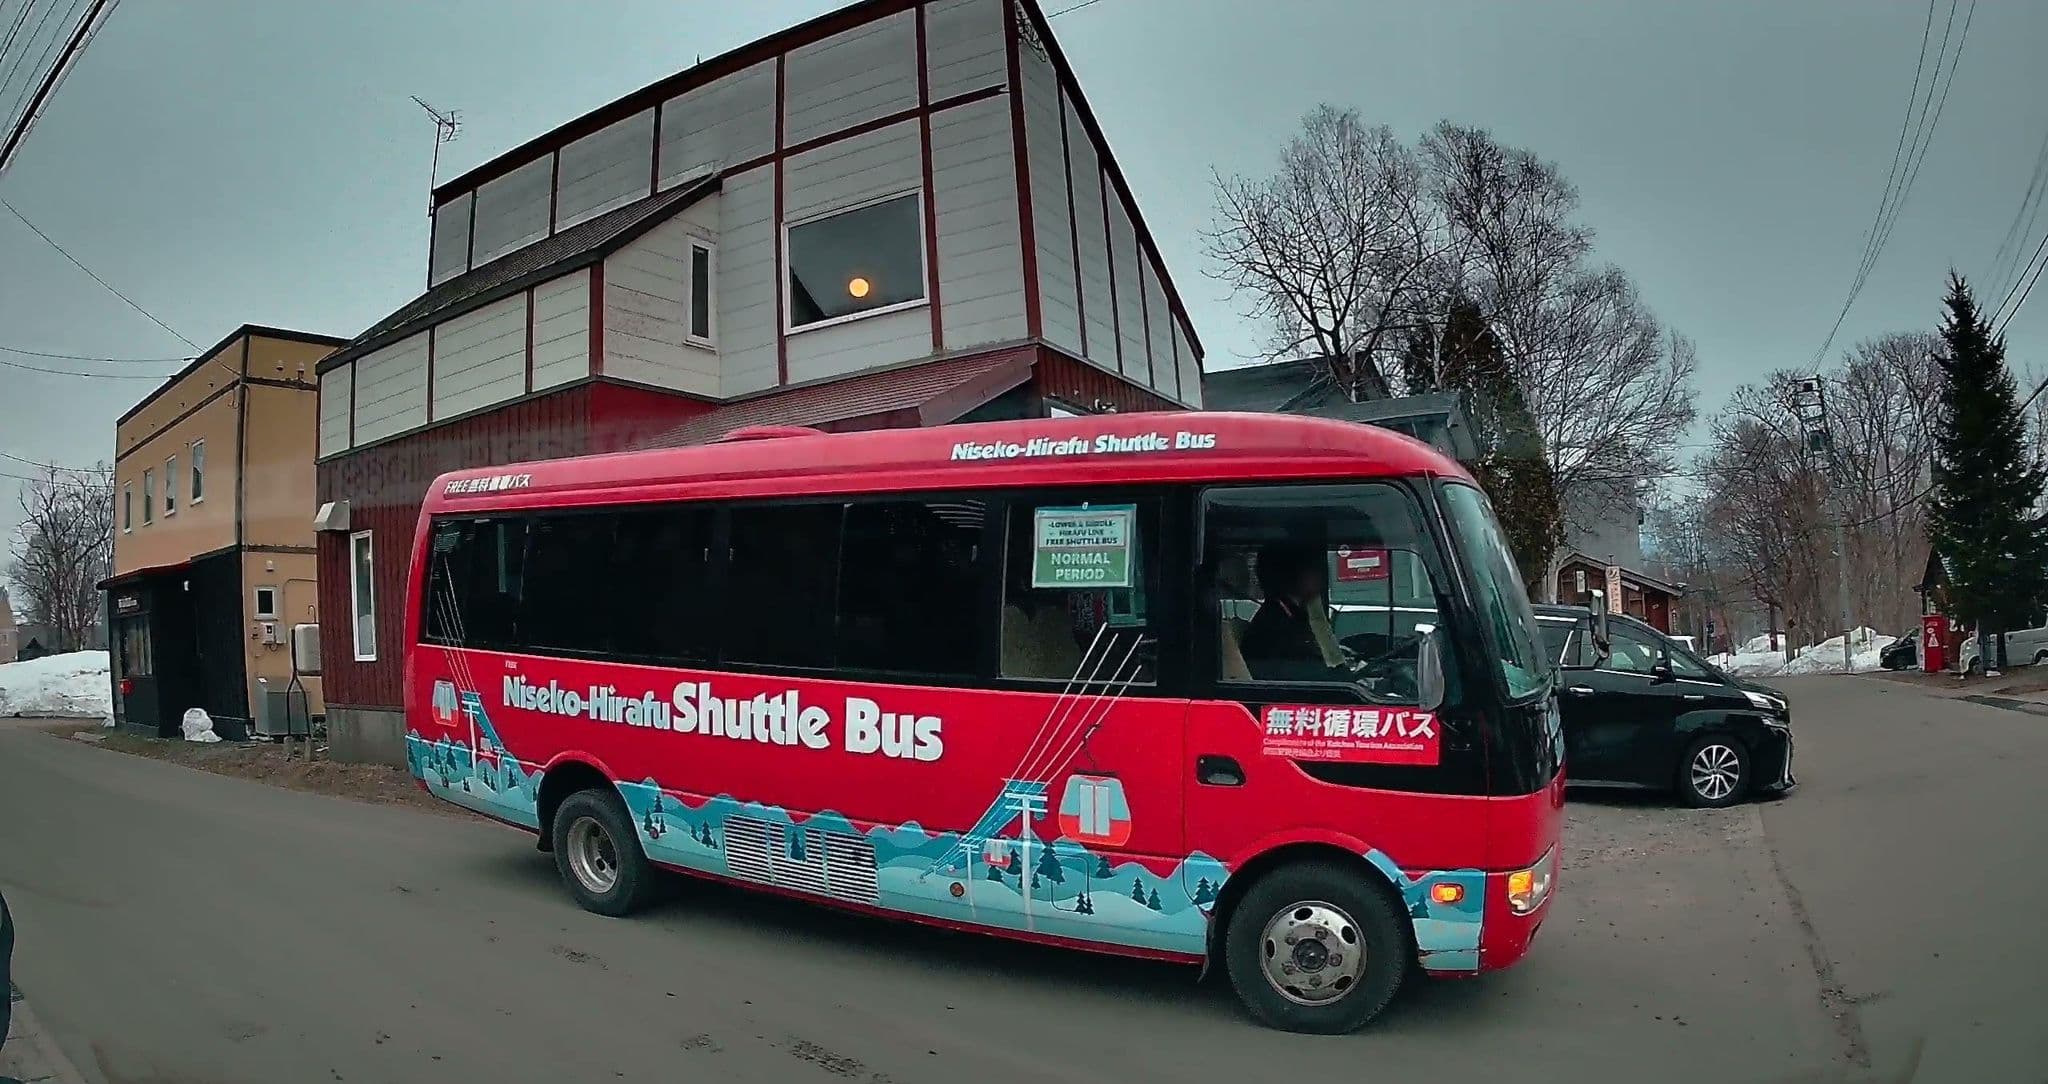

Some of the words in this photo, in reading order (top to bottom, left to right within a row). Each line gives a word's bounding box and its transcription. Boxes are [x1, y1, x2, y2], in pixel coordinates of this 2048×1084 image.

[951, 436, 1089, 461] Niseko-Hirafu
[1094, 432, 1169, 454] Shuttle
[1175, 431, 1216, 449] Bus
[444, 480, 471, 494] FREE
[1046, 538, 1064, 546] FREE
[1102, 537, 1118, 545] BUS
[1051, 552, 1111, 565] NORMAL
[1055, 568, 1105, 581] PERIOD
[503, 673, 671, 730] Niseko-Hirafu
[673, 681, 831, 749] Shuttle
[845, 697, 944, 761] Bus
[1266, 706, 1436, 739] 無料循環バス
